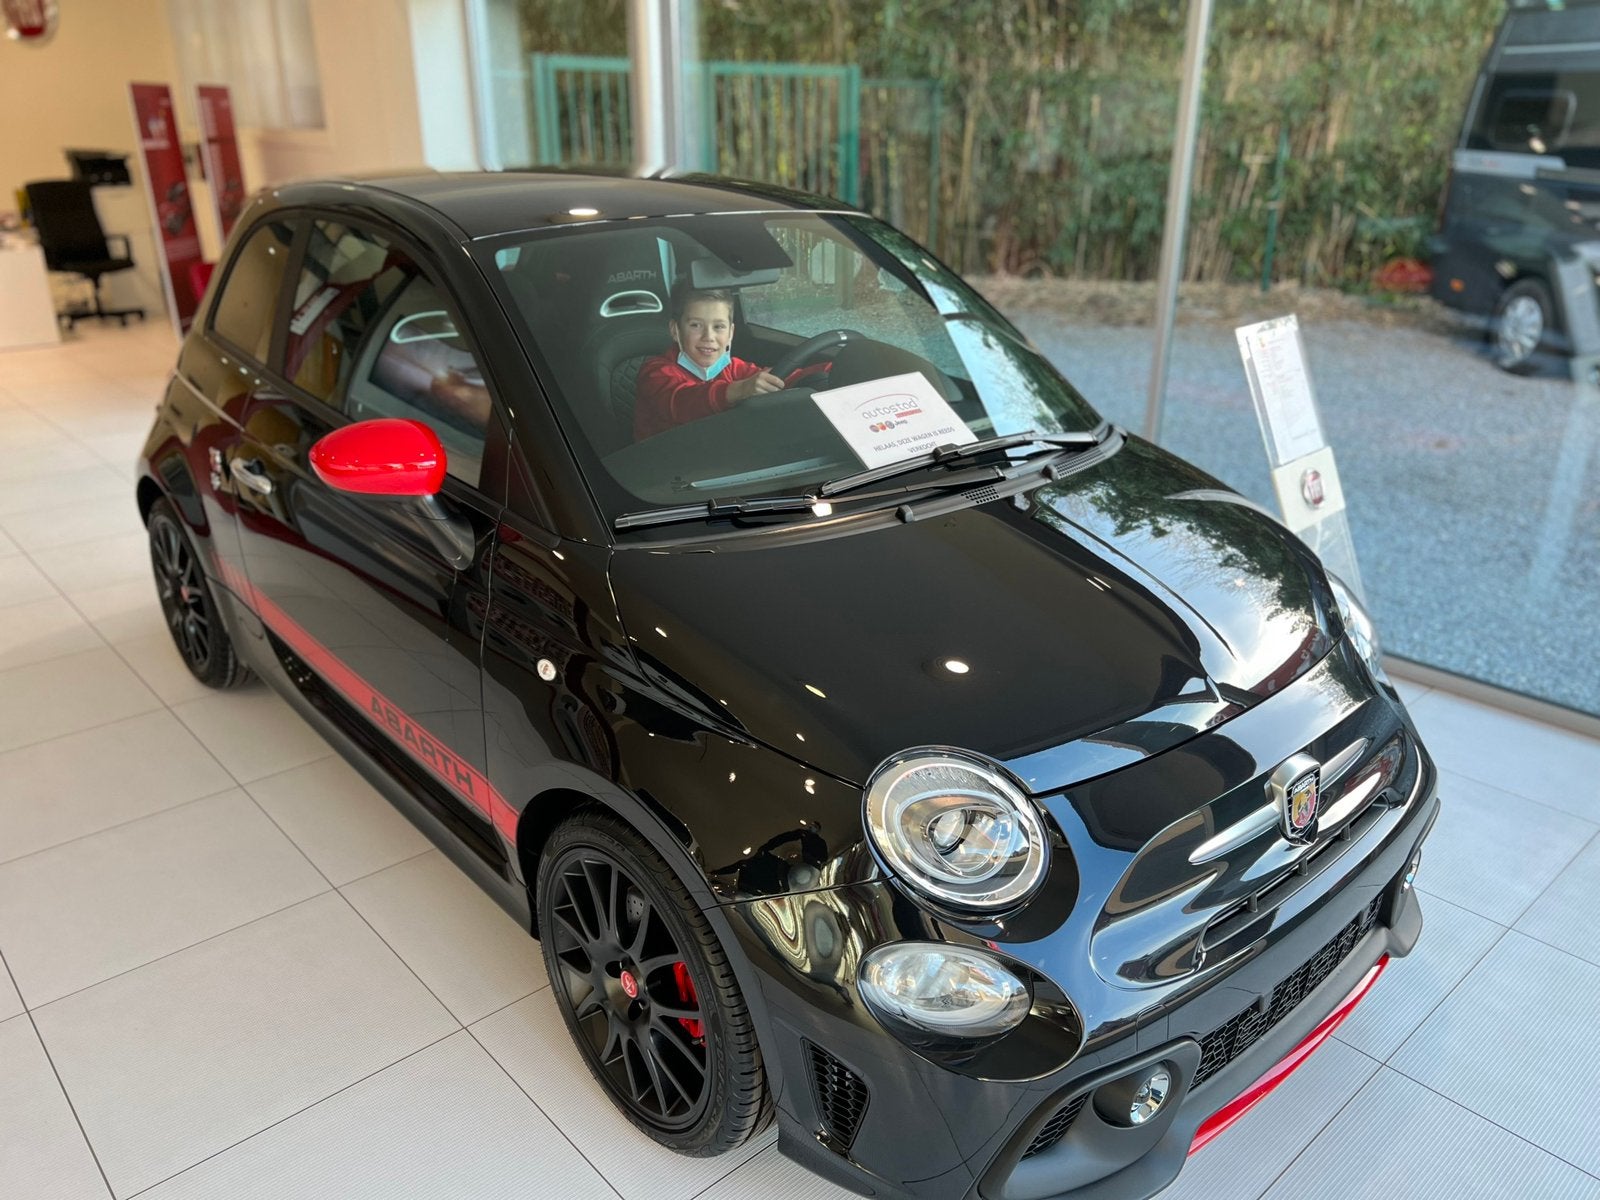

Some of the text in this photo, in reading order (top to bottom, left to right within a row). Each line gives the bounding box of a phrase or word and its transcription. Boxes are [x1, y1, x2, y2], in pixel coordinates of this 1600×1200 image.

[606, 270, 657, 283] ABARTH
[862, 399, 918, 419] autostad
[371, 696, 475, 797] ABARTH
